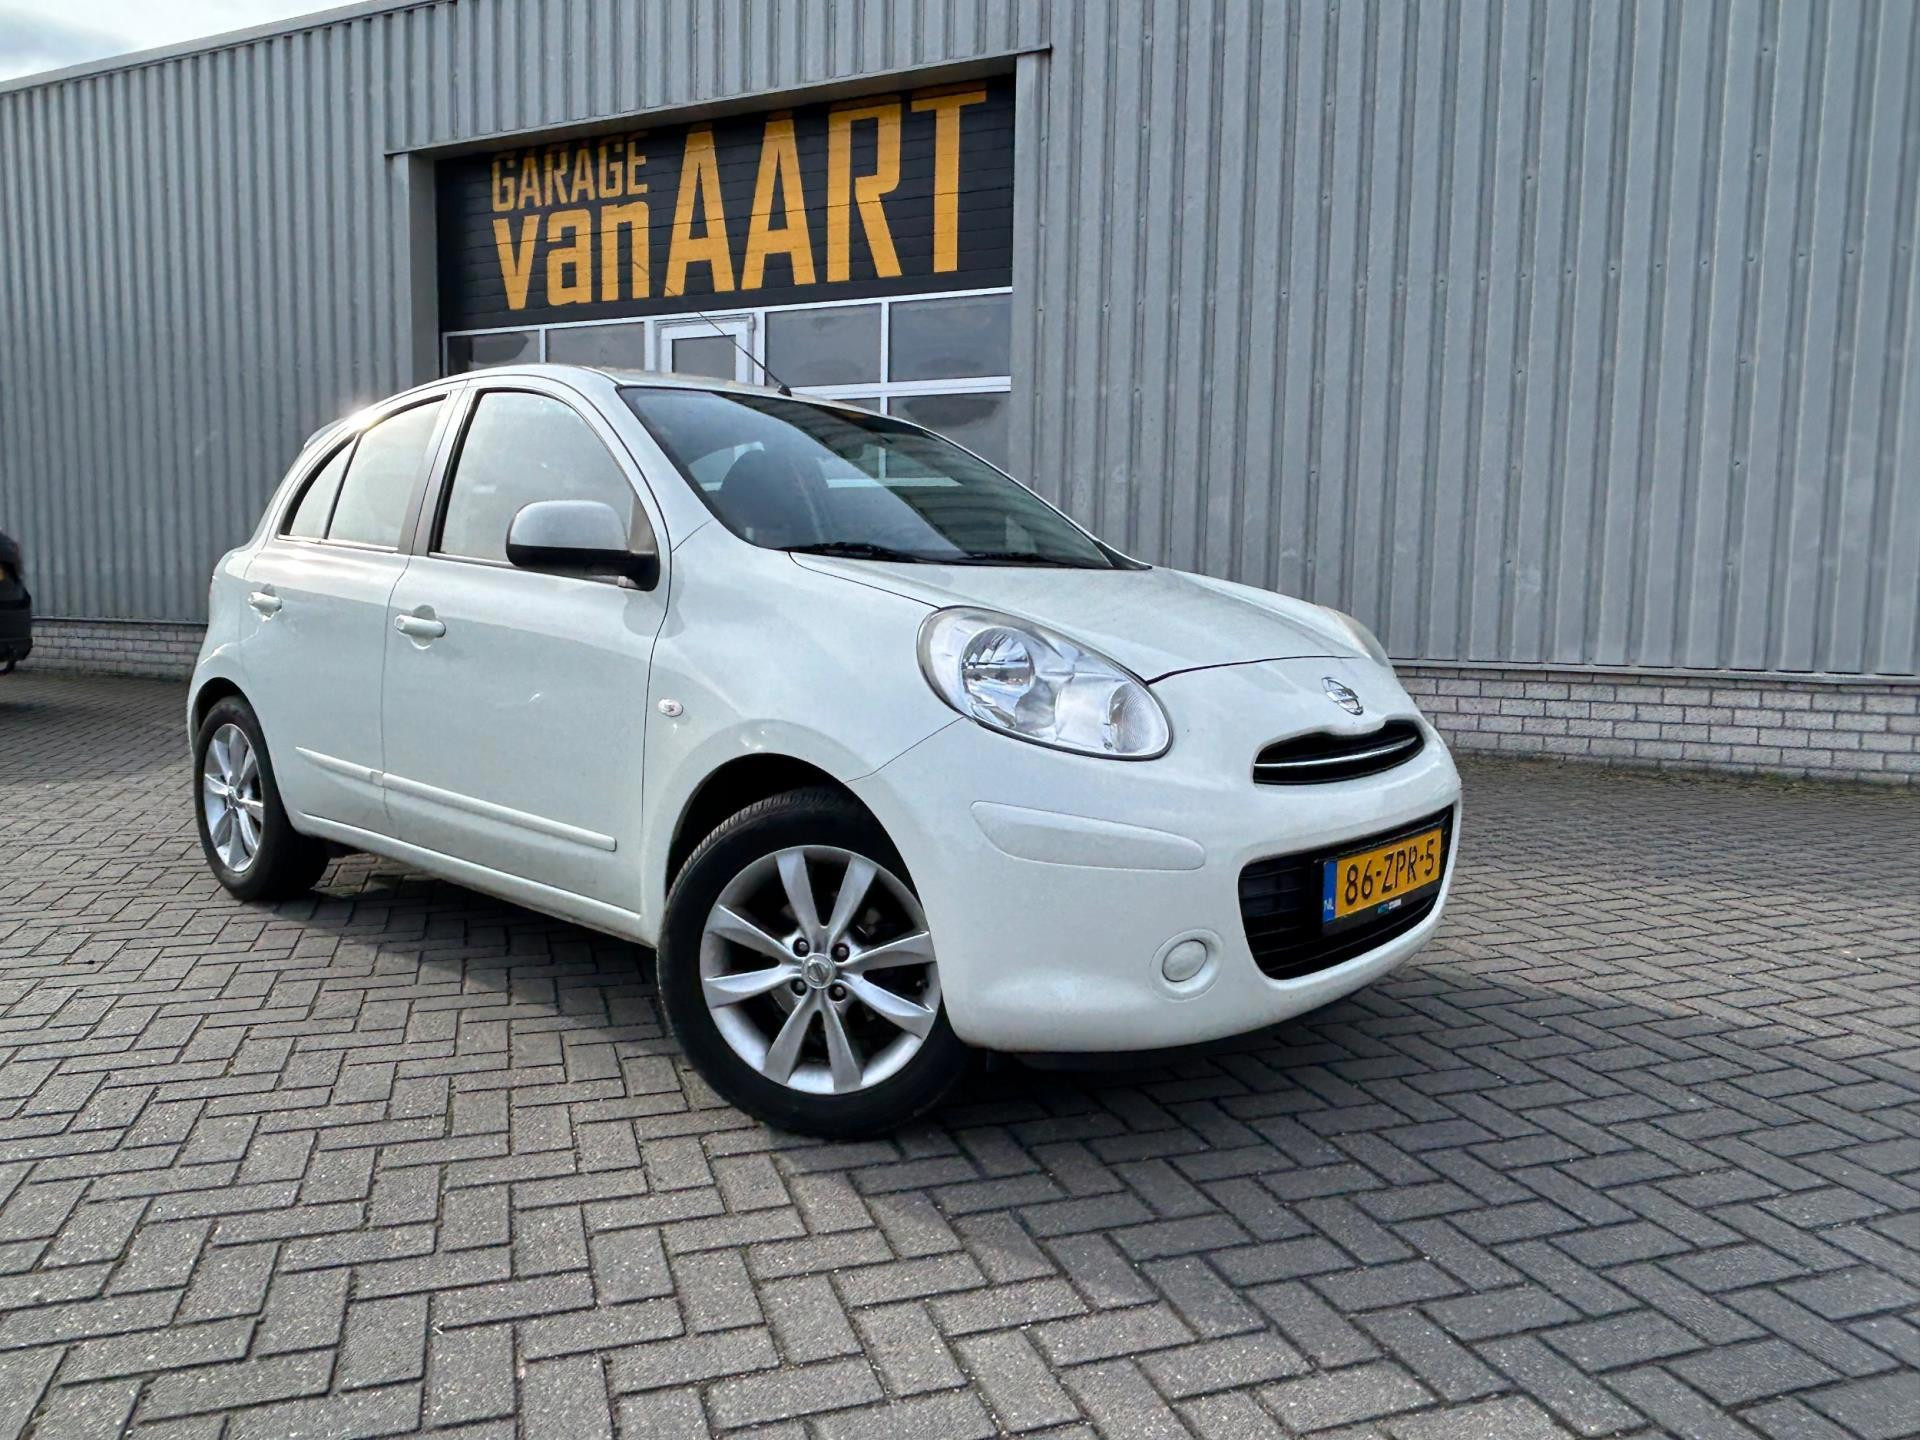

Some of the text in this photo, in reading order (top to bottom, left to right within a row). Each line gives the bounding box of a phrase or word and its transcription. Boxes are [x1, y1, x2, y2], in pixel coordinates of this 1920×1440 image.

[491, 132, 648, 212] GARAGE
[492, 82, 987, 311] van AART
[1323, 897, 1334, 912] NL
[1344, 838, 1435, 906] 86-ZPR-5
